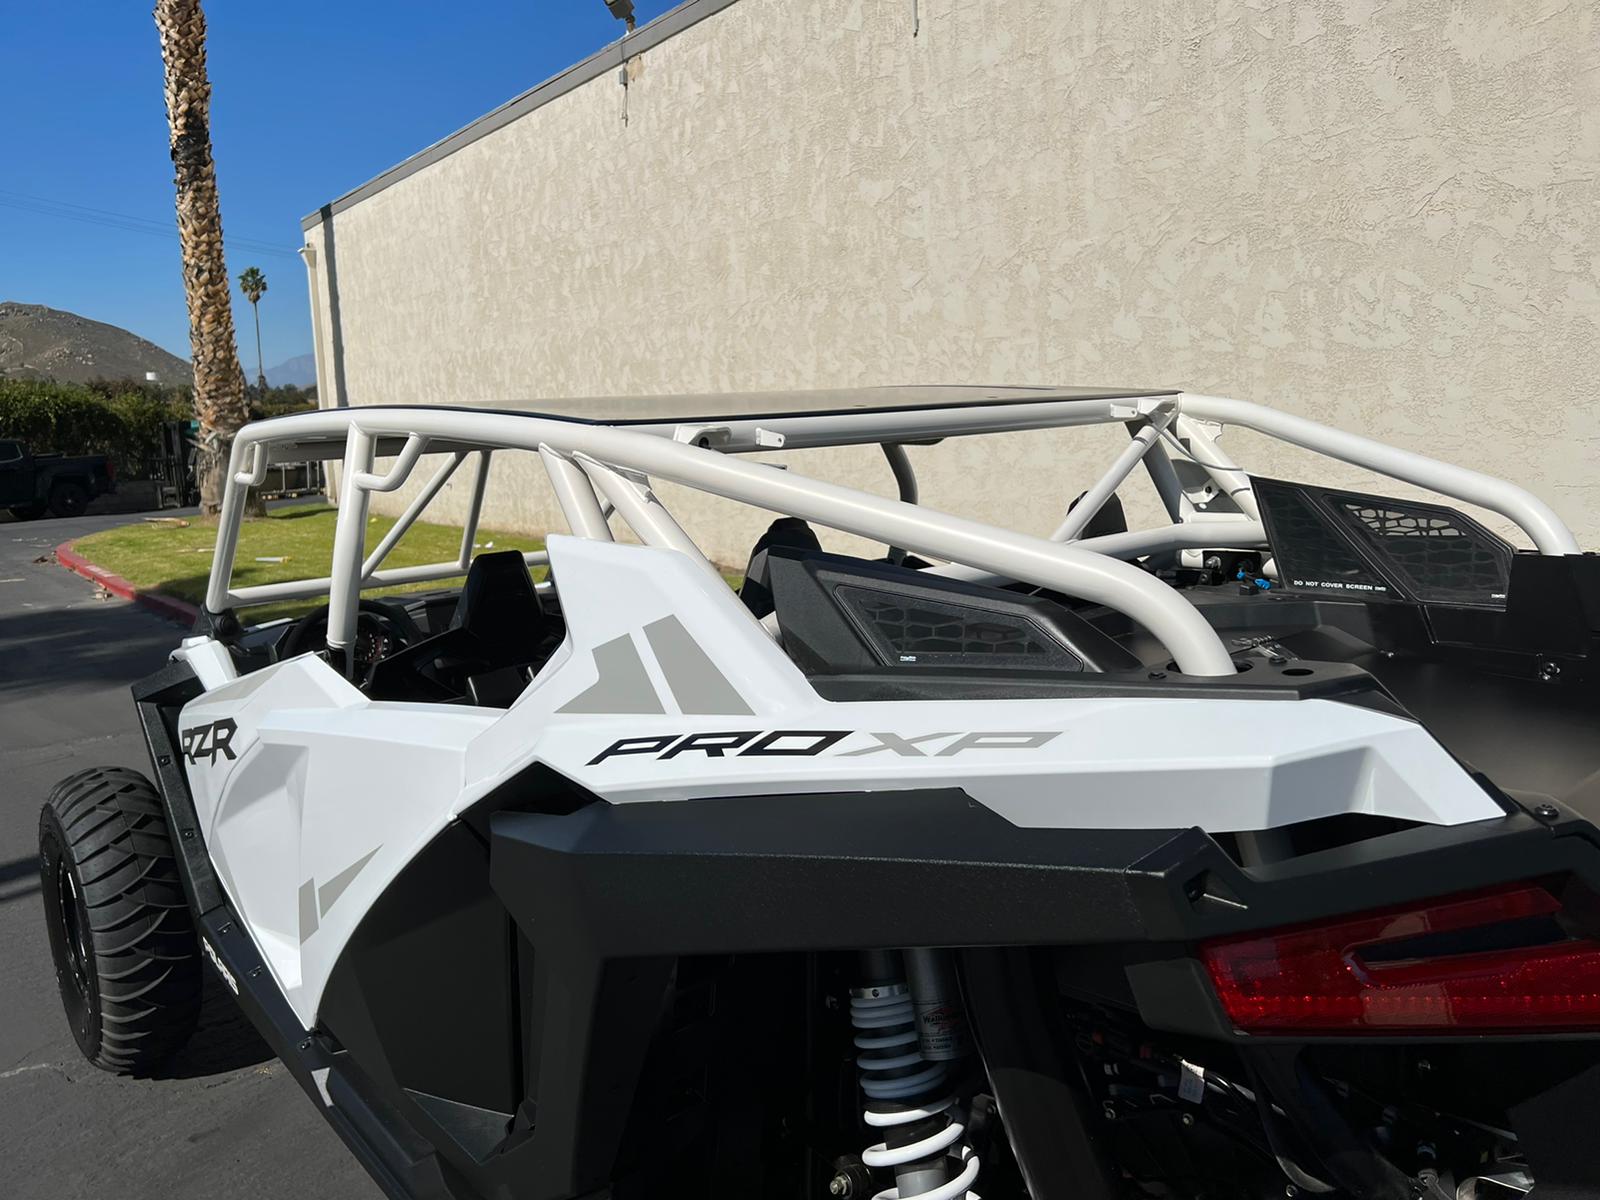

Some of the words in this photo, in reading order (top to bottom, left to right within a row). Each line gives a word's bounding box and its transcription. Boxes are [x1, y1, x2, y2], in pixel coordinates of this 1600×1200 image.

[1345, 583, 1373, 591] SCREEN
[181, 717, 239, 768] RZR
[584, 730, 855, 766] PRO
[833, 731, 1064, 757] XP
